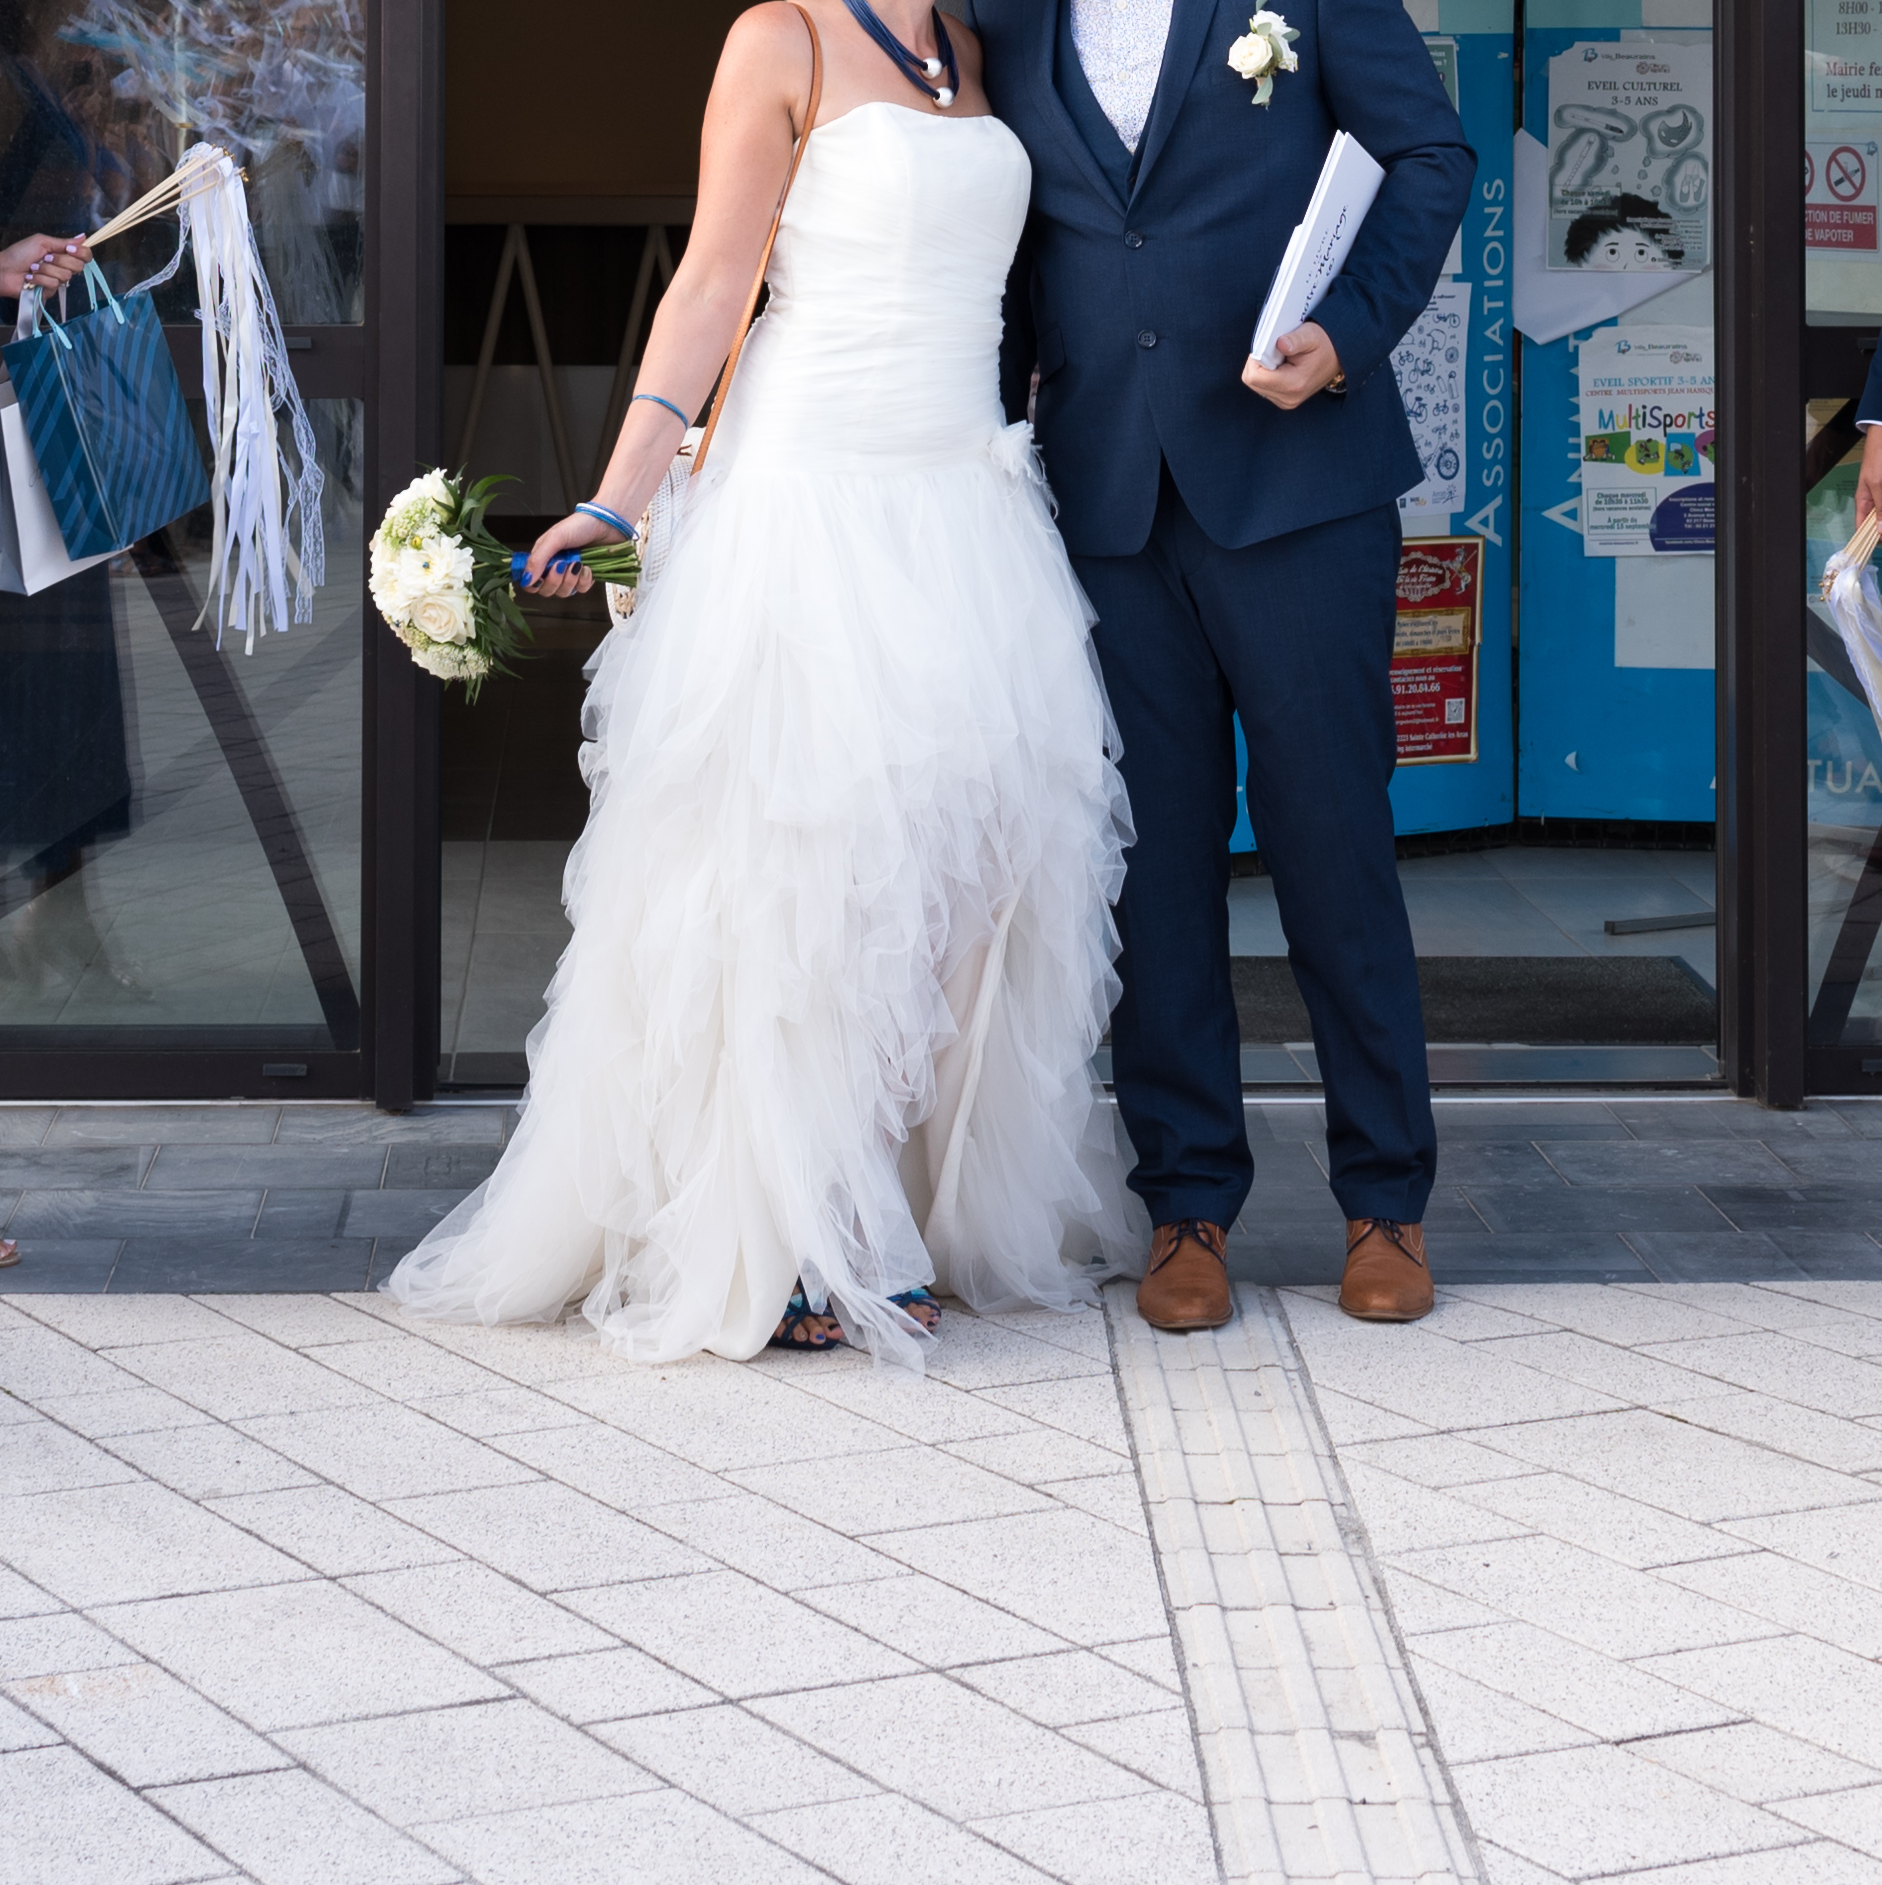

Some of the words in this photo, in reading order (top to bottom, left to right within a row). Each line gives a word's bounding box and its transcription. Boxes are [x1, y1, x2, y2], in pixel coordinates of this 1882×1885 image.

[1838, 1, 1868, 15] 8H00
[1835, 21, 1871, 35] 13H30
[1826, 62, 1865, 76] Mairie
[1587, 80, 1620, 92] EVEIL
[1622, 80, 1683, 92] CULTUREL
[1611, 95, 1632, 106] 3-5
[1635, 96, 1659, 106] ANS
[1827, 84, 1838, 98] le
[1840, 84, 1871, 103] jeudi
[1806, 210, 1828, 223] TION
[1829, 211, 1842, 224] DE
[1843, 211, 1874, 225] FUMER
[1814, 228, 1854, 242] VAPOTER
[1463, 177, 1506, 547] ASSOCIATIONS
[1593, 377, 1625, 388] EVEIL
[1627, 376, 1675, 387] SPORTIF
[1677, 376, 1697, 386] 3-5
[1585, 389, 1613, 397] CENTRE
[1616, 388, 1667, 396] MULTISPORTS
[1667, 387, 1685, 396] JEAN
[1598, 403, 1715, 438] MultiSports
